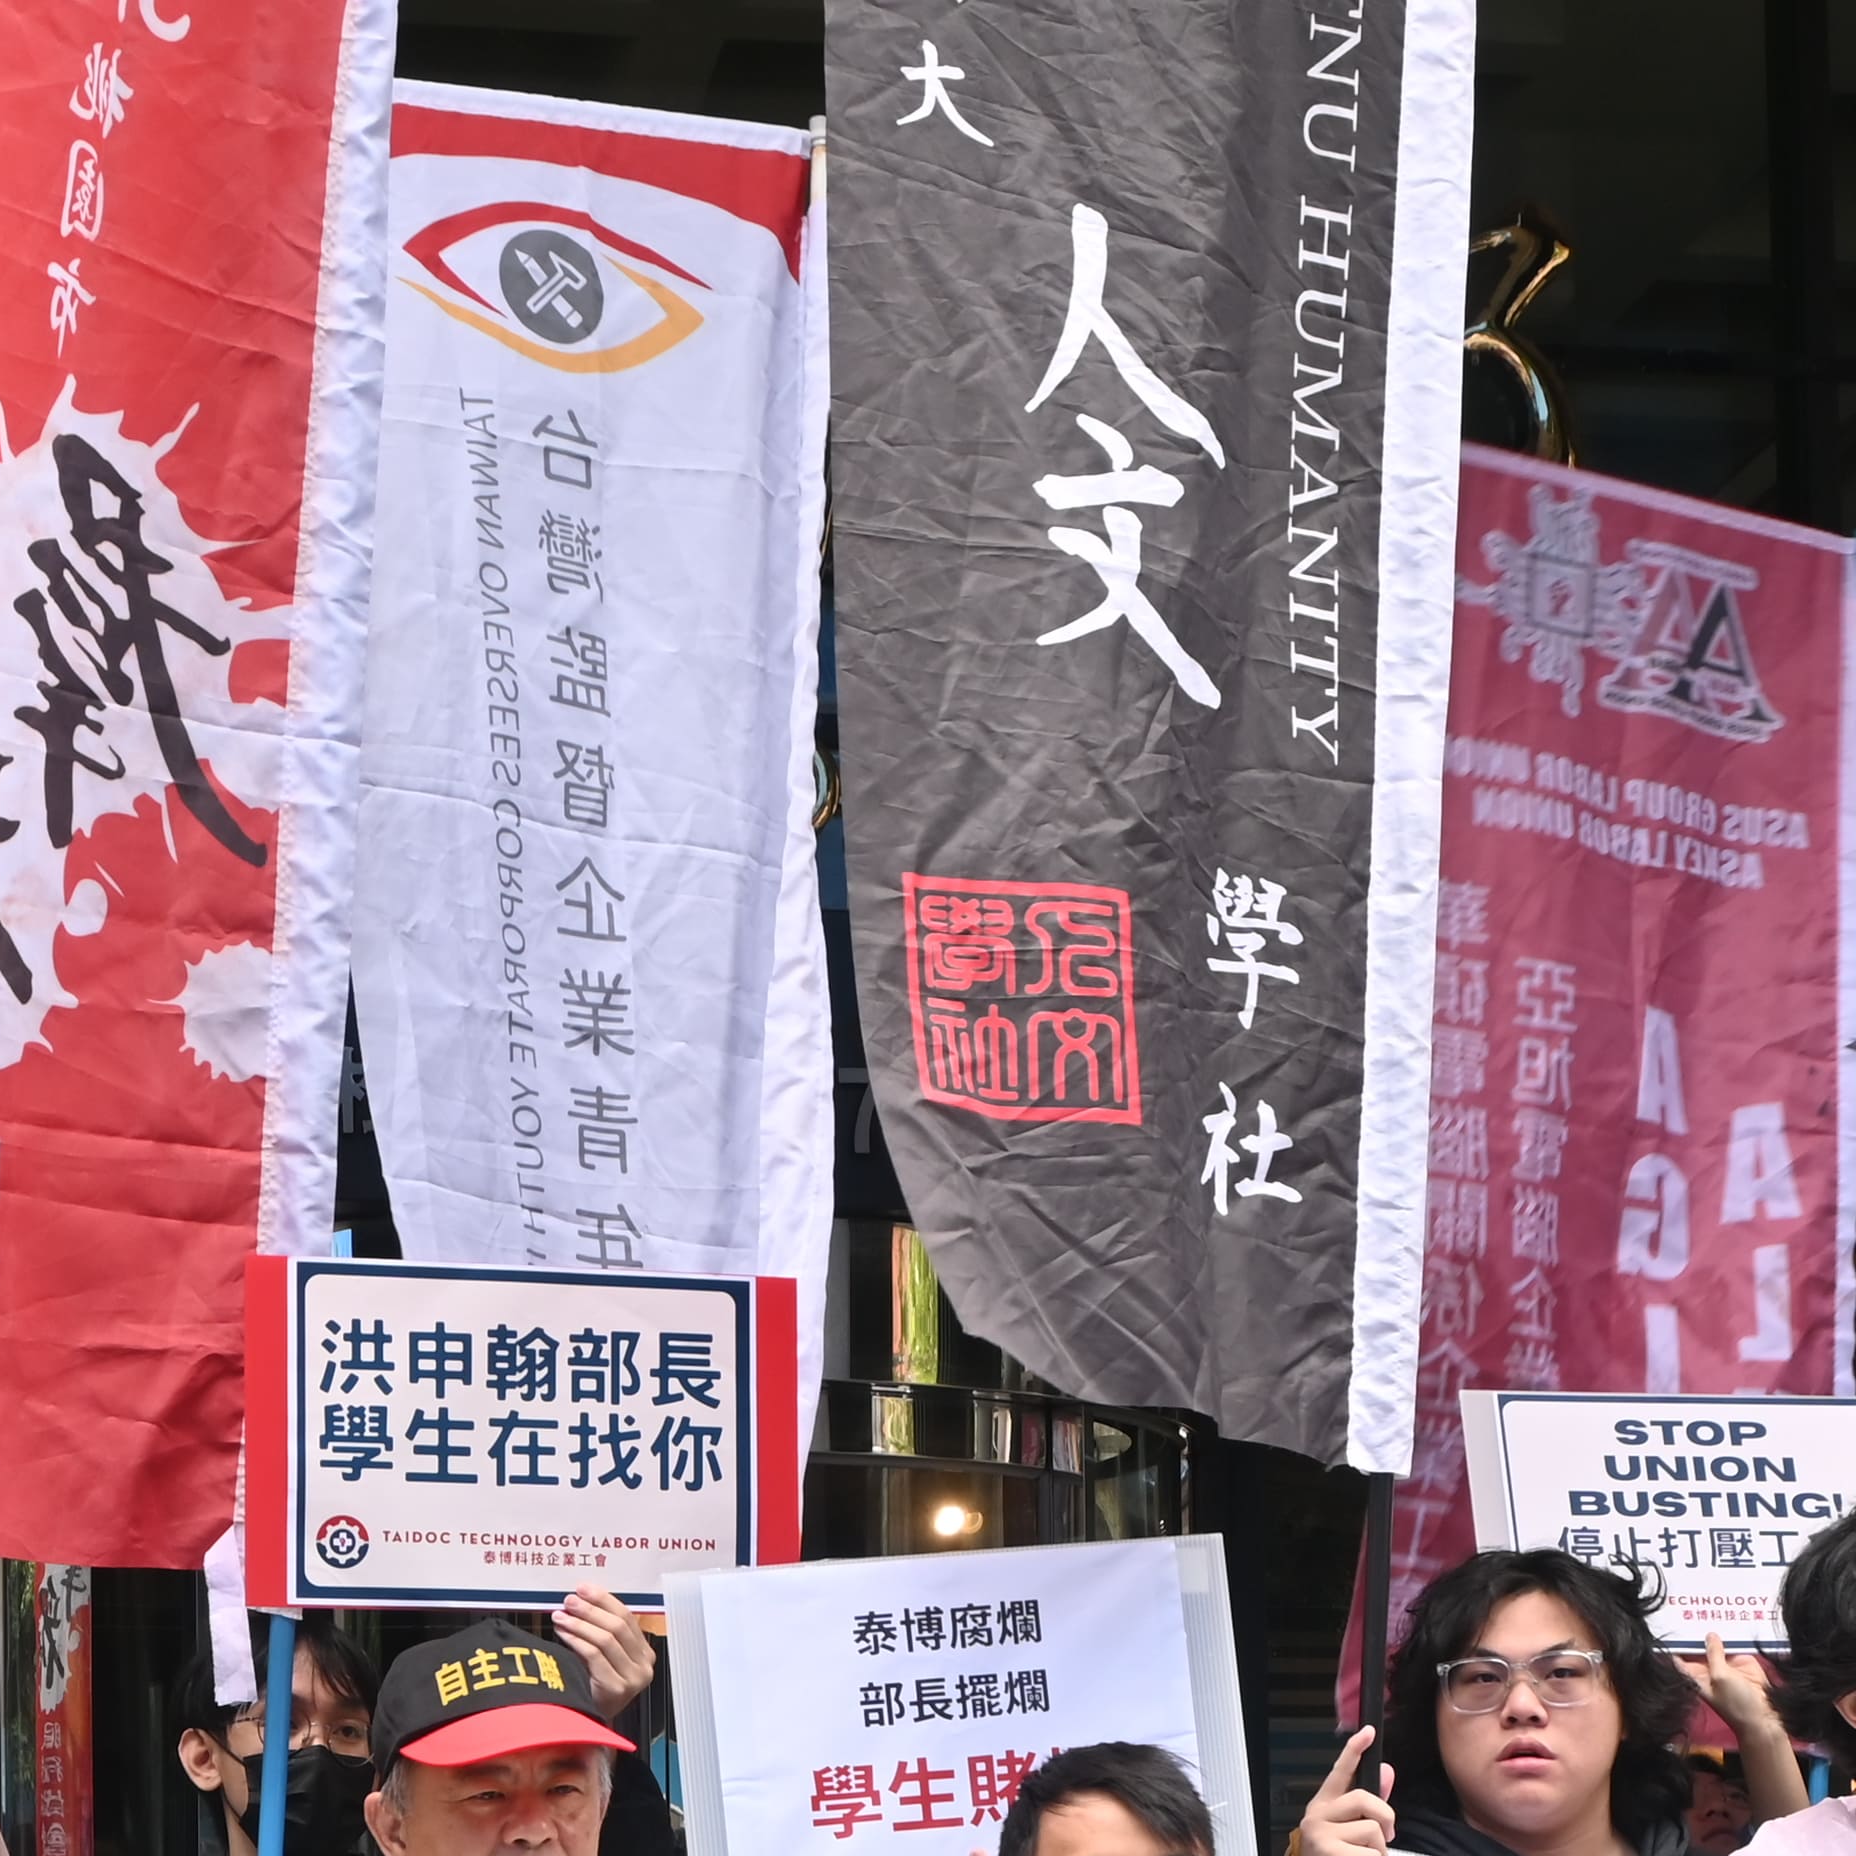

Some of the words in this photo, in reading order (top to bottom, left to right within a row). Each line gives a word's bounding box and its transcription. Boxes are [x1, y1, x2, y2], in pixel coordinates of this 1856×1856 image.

[896, 39, 995, 147] 大
[1302, 0, 1366, 173] NU
[1023, 202, 1227, 710] 人文
[1287, 194, 1354, 765] HUMANITY
[1199, 865, 1305, 1218] 學社
[318, 1317, 722, 1409] 洪申翰部長
[318, 1403, 724, 1492] 學生在找你
[1613, 1419, 1768, 1446] STOP
[1603, 1455, 1797, 1483] UNION
[1568, 1490, 1844, 1519] BUSTING!
[382, 1530, 452, 1545] TAIDOC
[460, 1531, 583, 1549] TECHNOLOGY
[591, 1535, 650, 1551] LABOR
[658, 1538, 717, 1552] UNION
[482, 1550, 607, 1568] 泰博科技企業工會
[1557, 1526, 1821, 1569] 停止打壓工
[853, 1599, 1043, 1656] 泰博腐爛
[1663, 1595, 1769, 1606] ECHNOLOGY
[434, 1645, 566, 1706] 自主工聯
[858, 1667, 1051, 1728] 部長擺爛
[810, 1746, 1075, 1840] 學生賭
